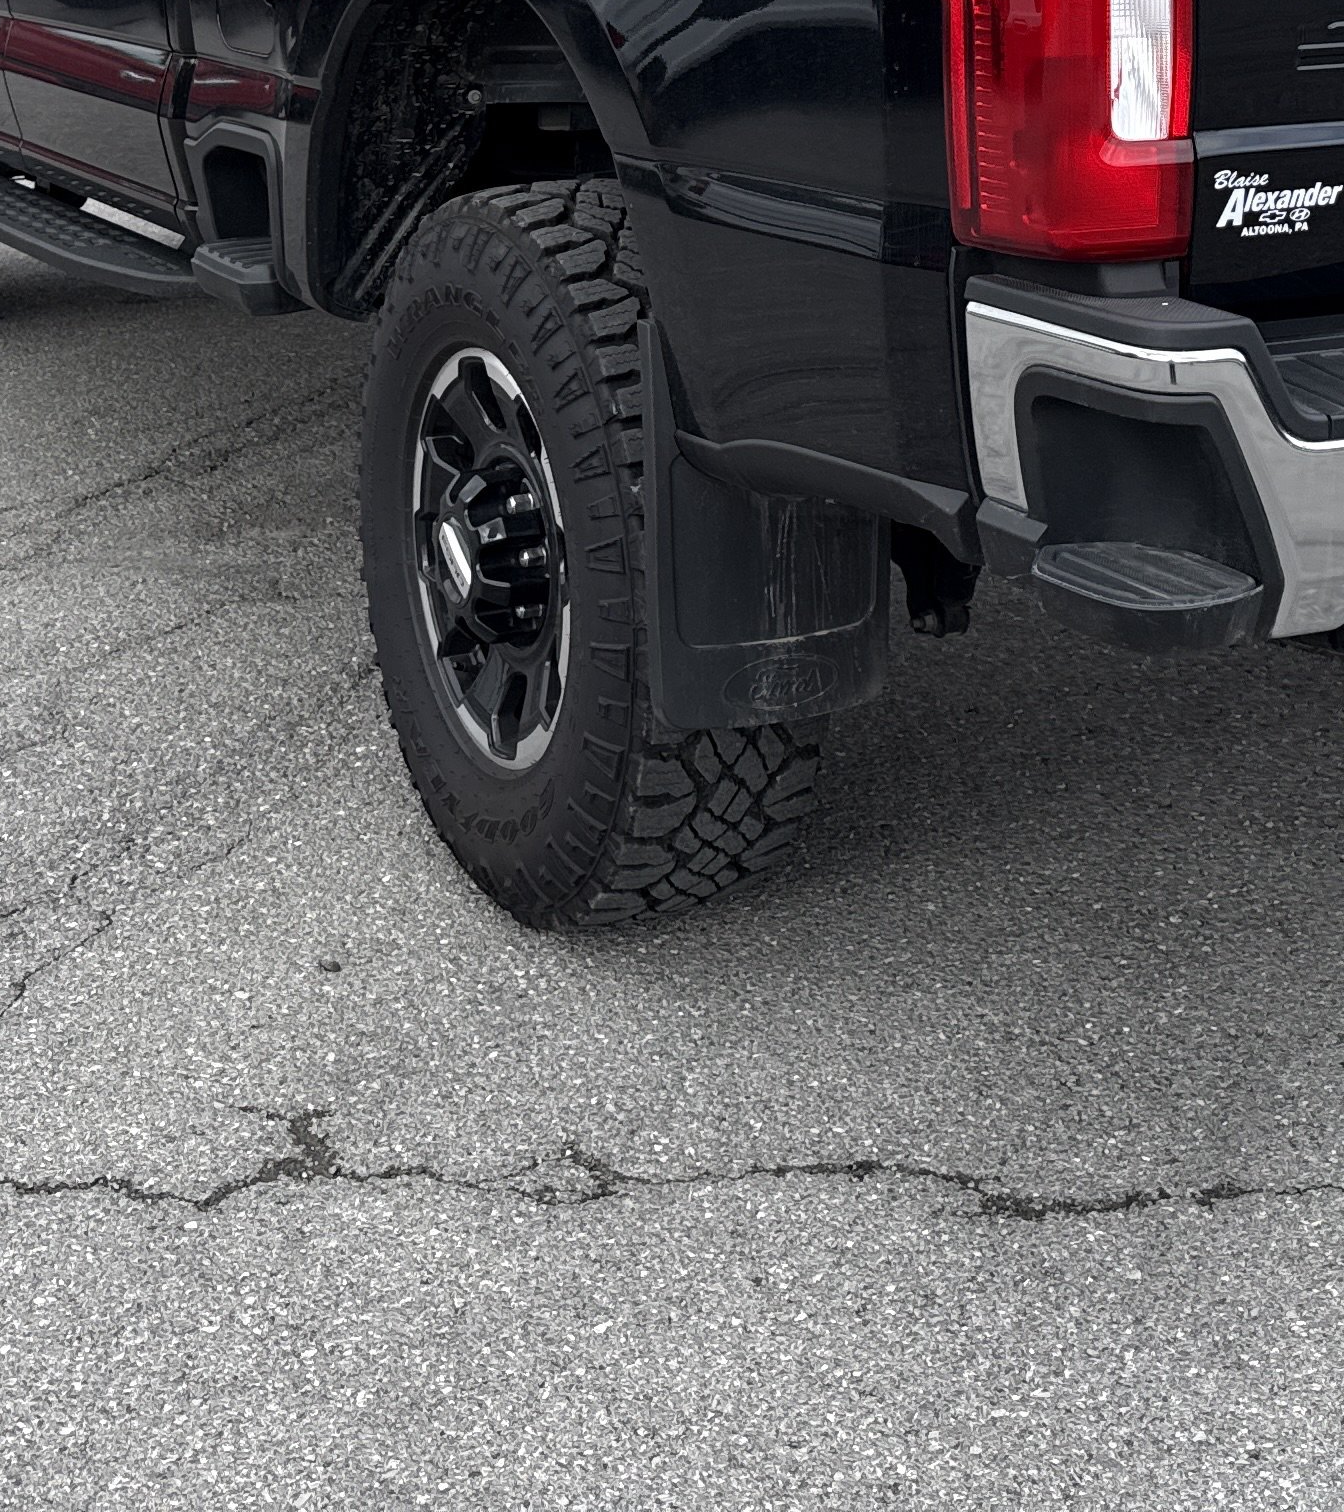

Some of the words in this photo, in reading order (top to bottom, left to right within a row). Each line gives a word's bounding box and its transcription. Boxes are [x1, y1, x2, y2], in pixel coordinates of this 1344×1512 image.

[1214, 170, 1269, 189] Blaise
[1216, 182, 1343, 227] Alexander
[1295, 222, 1309, 231] PA
